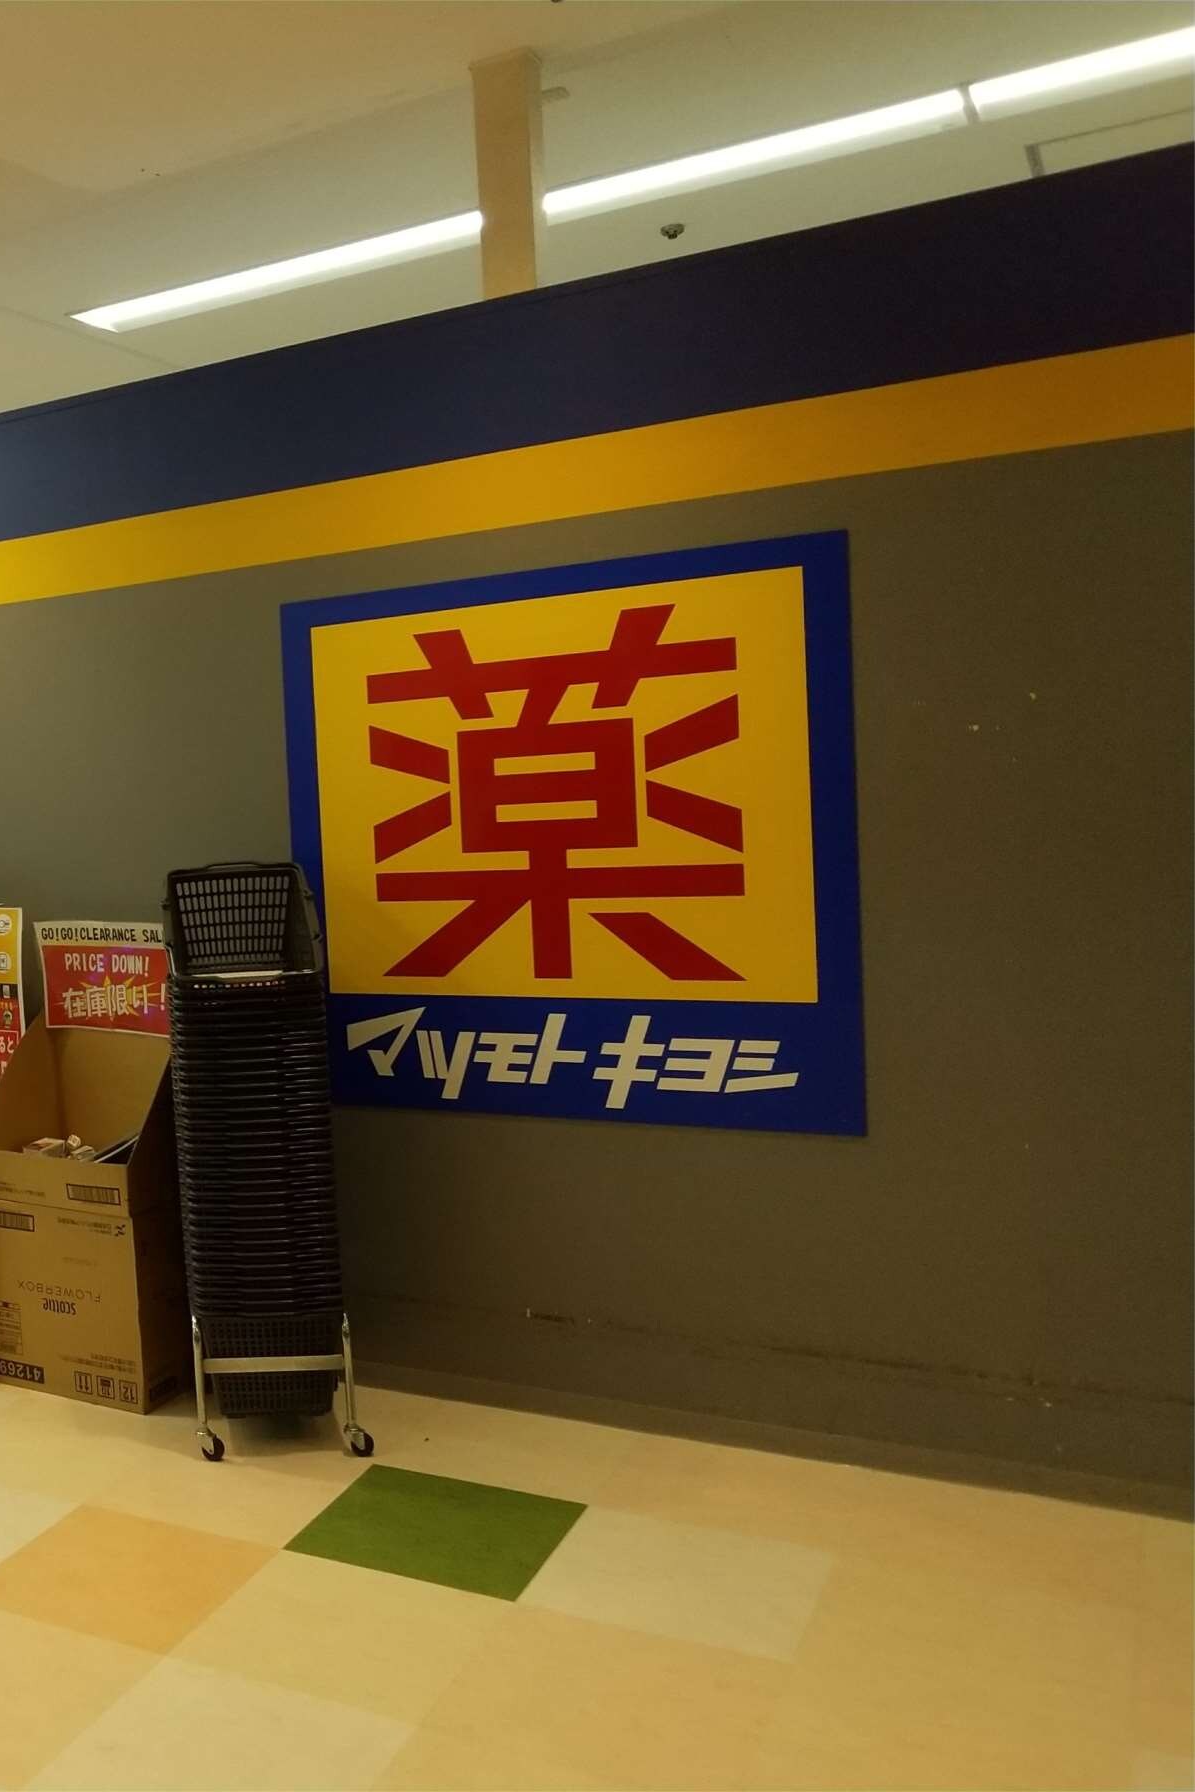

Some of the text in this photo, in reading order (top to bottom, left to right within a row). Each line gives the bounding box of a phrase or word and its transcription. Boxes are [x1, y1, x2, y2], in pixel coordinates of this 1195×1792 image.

[366, 604, 748, 982] 薬
[64, 953, 150, 977] PRICE DOWN!
[142, 928, 163, 943] SAL
[347, 1007, 799, 1110] マツモトキヨシ
